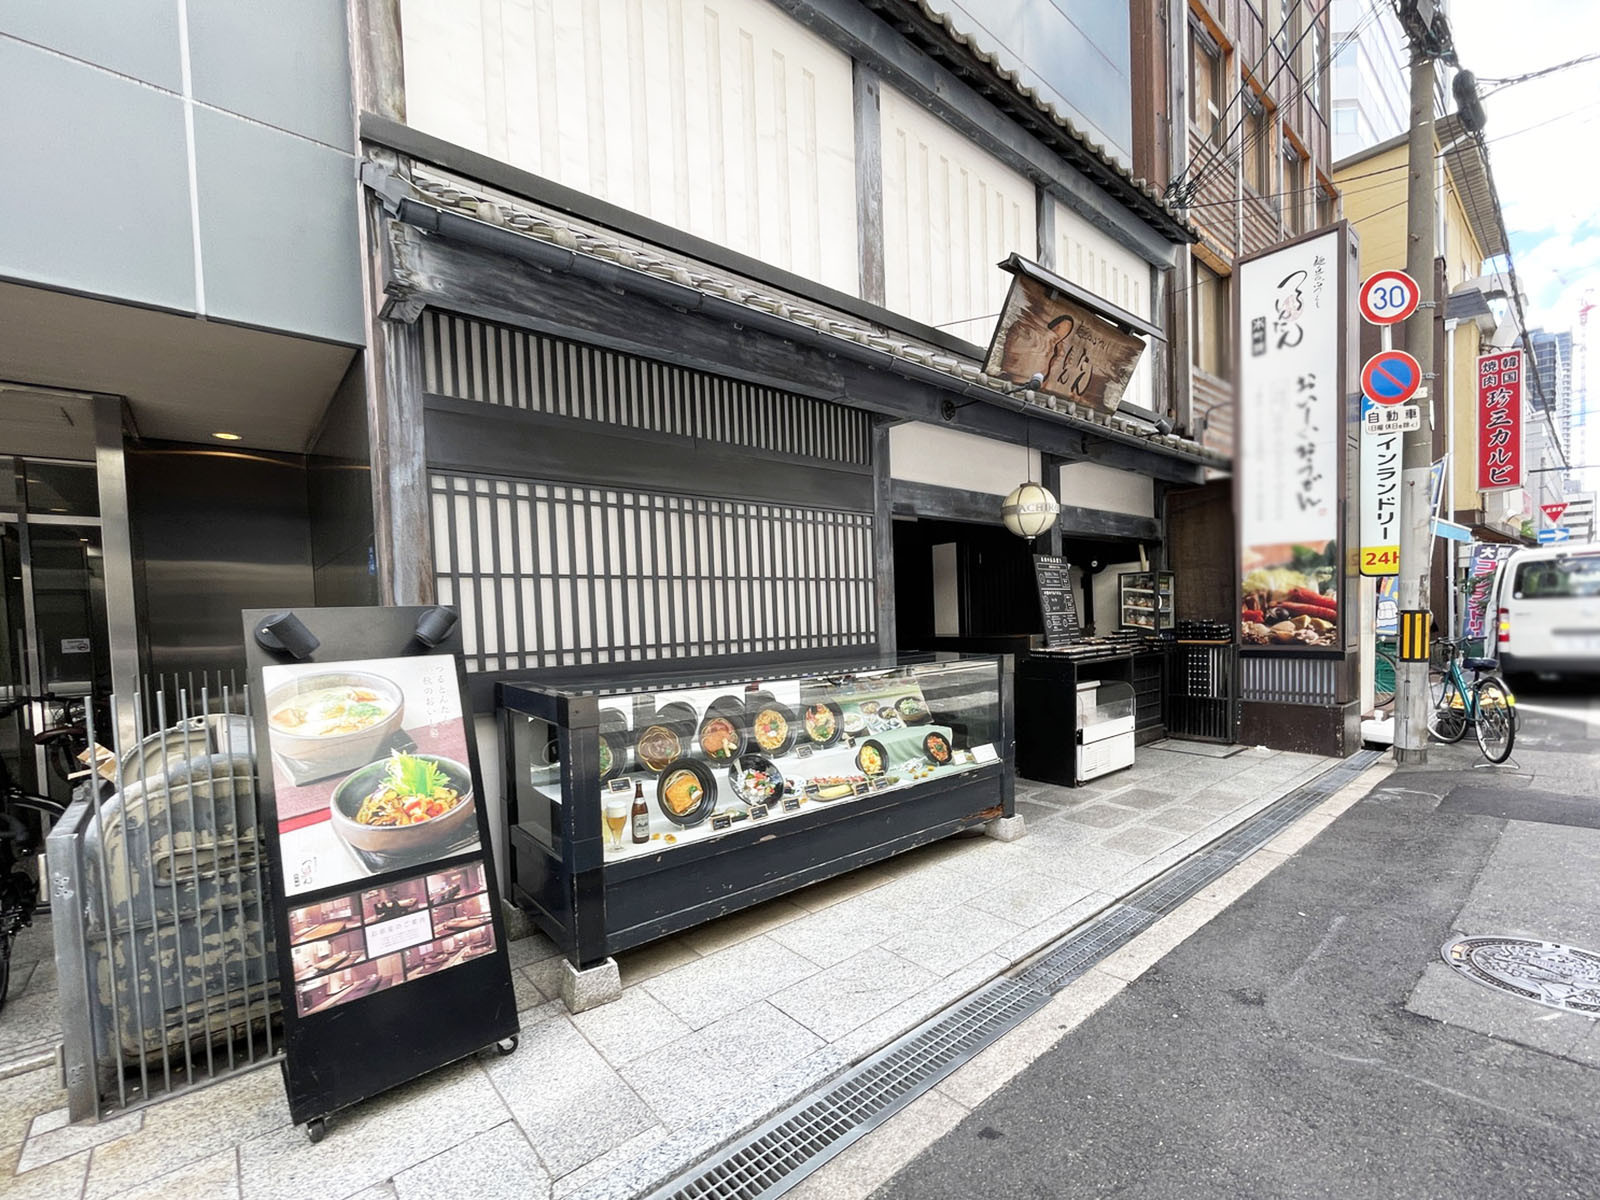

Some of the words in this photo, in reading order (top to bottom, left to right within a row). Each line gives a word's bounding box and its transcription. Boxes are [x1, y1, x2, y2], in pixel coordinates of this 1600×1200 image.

[1372, 285, 1406, 310] 30
[1482, 361, 1498, 388] 焼肉
[1502, 356, 1518, 384] 韓国
[1368, 408, 1418, 424] 自動車
[1376, 432, 1398, 540] インランドリー
